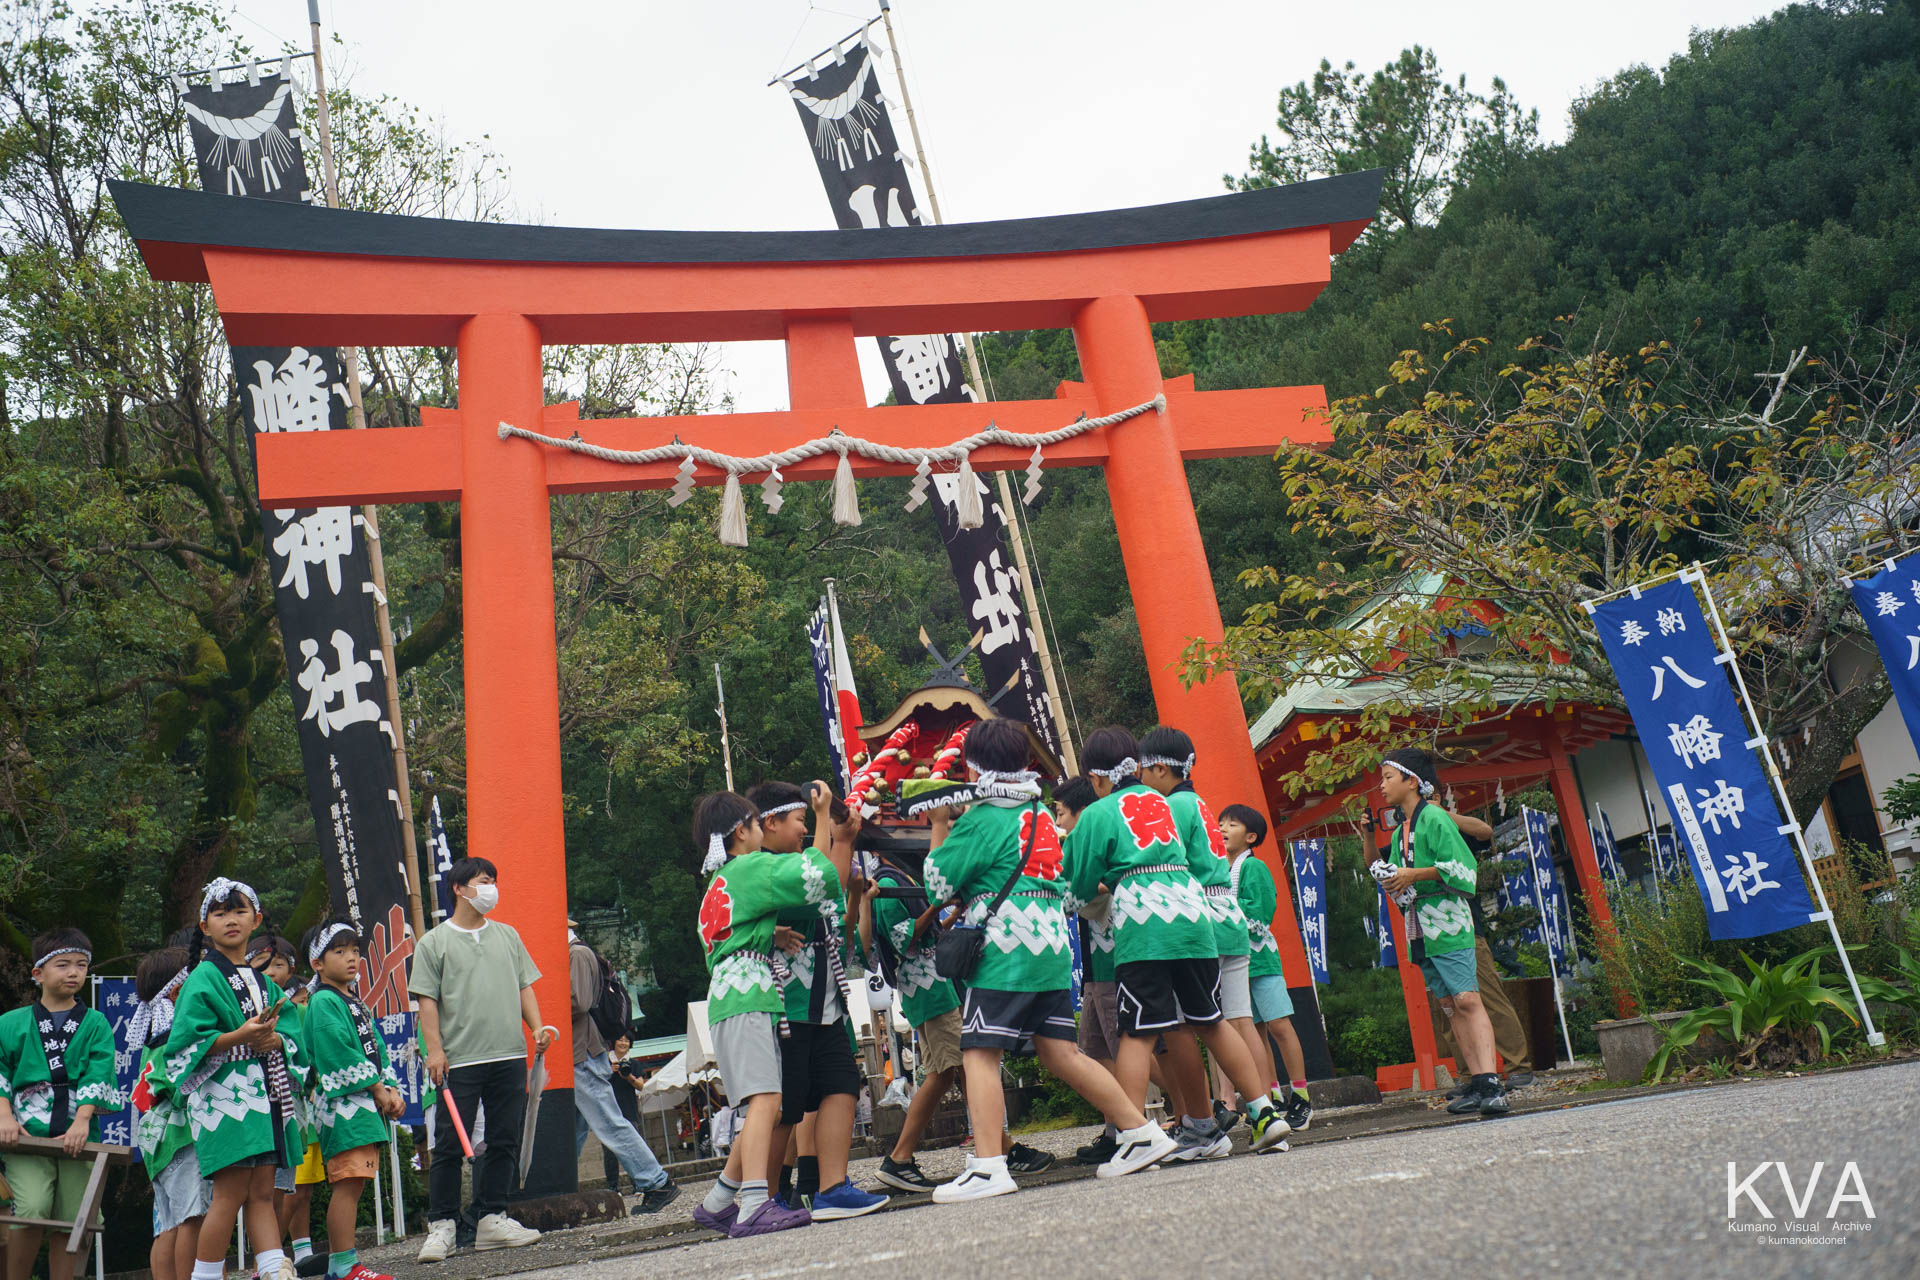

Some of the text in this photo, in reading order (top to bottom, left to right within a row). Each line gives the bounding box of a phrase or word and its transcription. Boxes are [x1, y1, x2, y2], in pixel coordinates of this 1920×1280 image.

[1620, 608, 1686, 646] 奉納
[329, 754, 341, 789] 奉納
[1650, 655, 1781, 904] 八幡神社
[1675, 795, 1712, 872] HAL CREW
[39, 1019, 64, 1071] 築地区
[349, 1003, 375, 1055] 築地区
